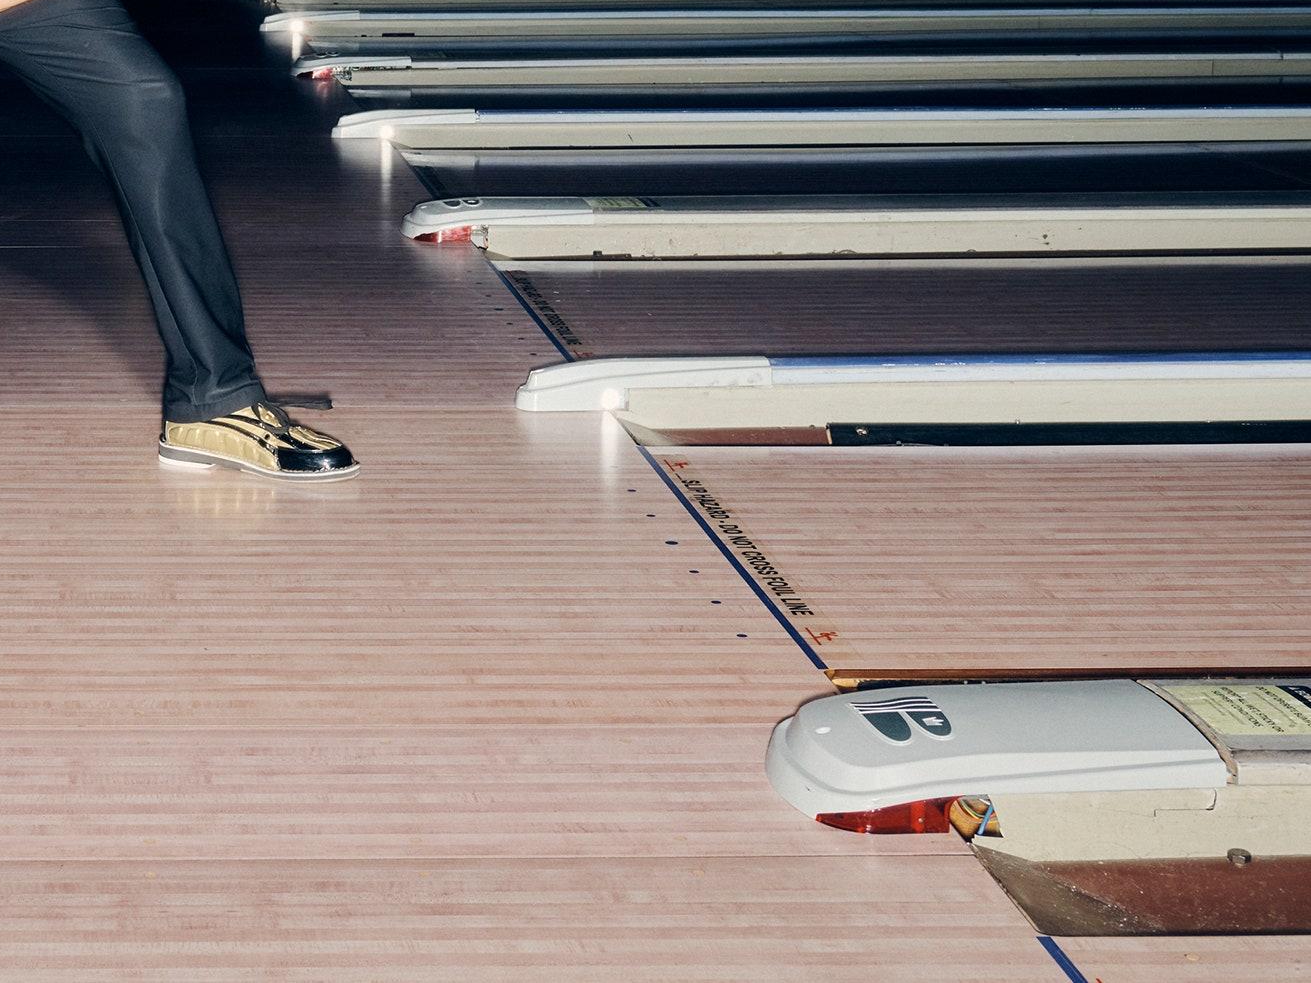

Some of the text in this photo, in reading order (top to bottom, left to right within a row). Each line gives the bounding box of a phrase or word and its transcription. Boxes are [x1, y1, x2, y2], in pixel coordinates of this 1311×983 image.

[682, 479, 708, 494] SLIP
[694, 494, 730, 519] HAZARD
[719, 524, 743, 534] DO
[728, 535, 757, 550] NOT
[742, 551, 779, 576] CROSS
[762, 576, 795, 597] FOUL
[780, 598, 814, 616] LINE
